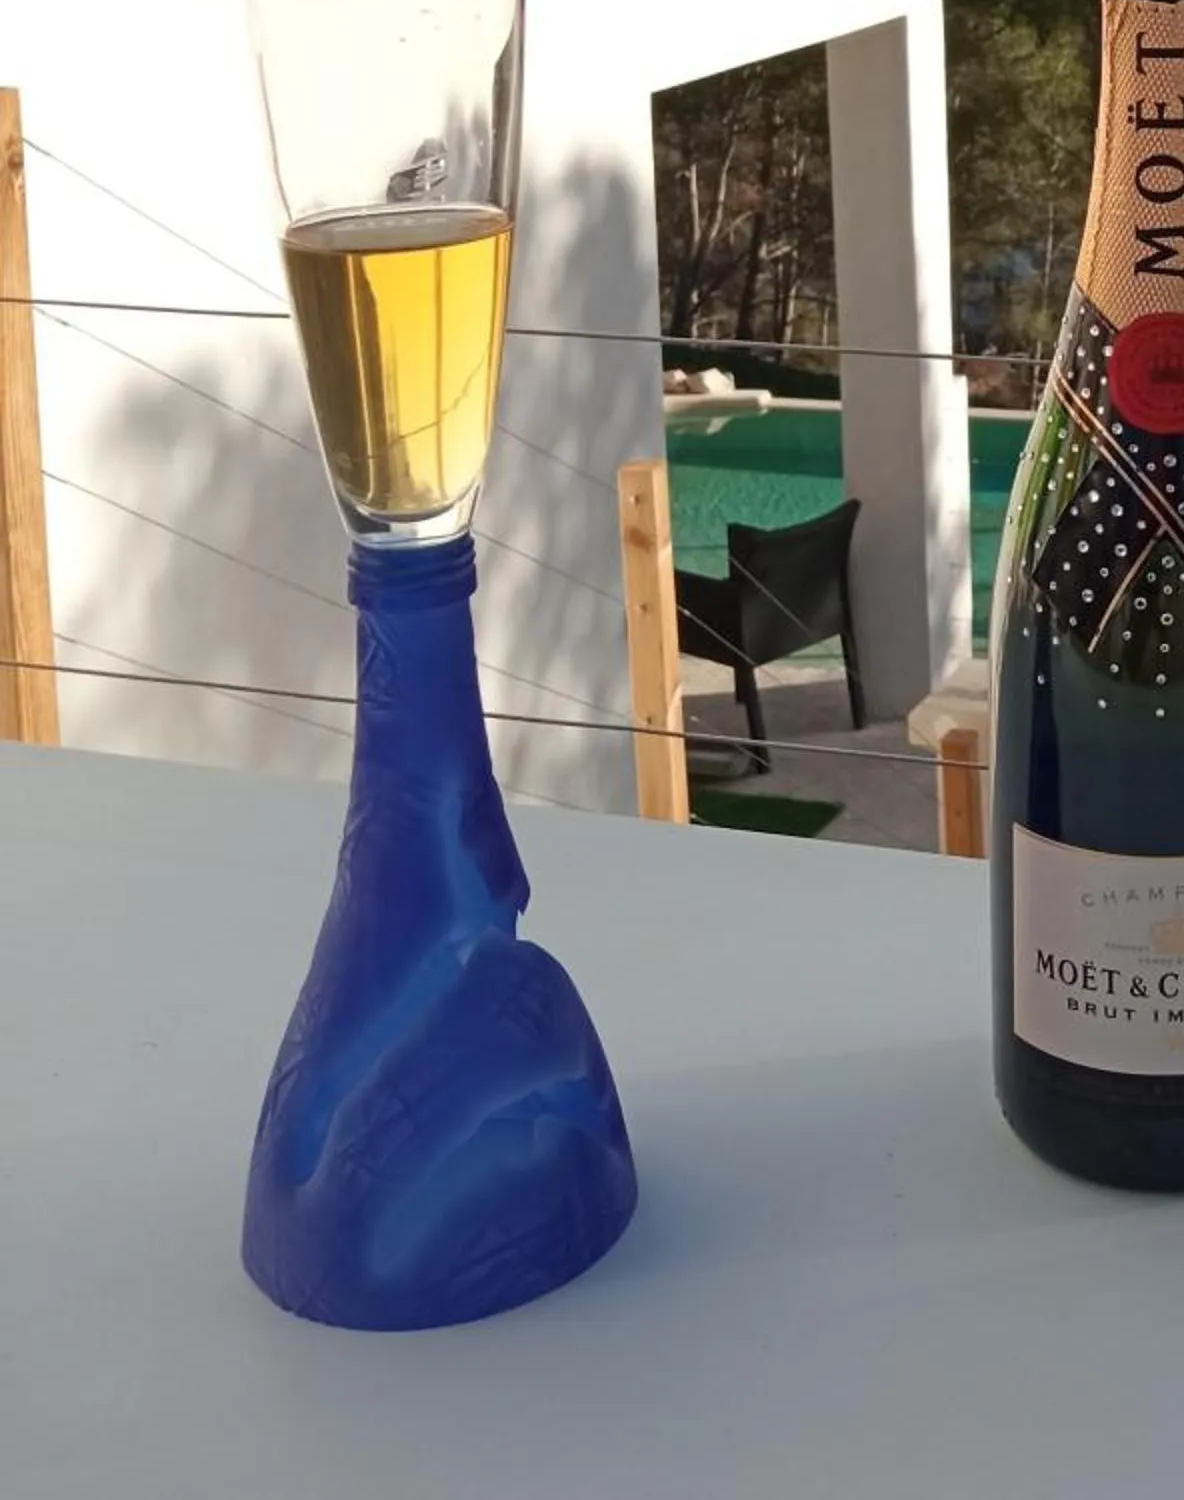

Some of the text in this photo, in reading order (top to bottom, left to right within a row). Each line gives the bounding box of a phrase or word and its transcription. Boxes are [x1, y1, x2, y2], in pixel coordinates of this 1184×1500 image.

[1035, 949, 1121, 997] MOËT
[1128, 975, 1149, 999] &
[1067, 998, 1137, 1022] BRUT
